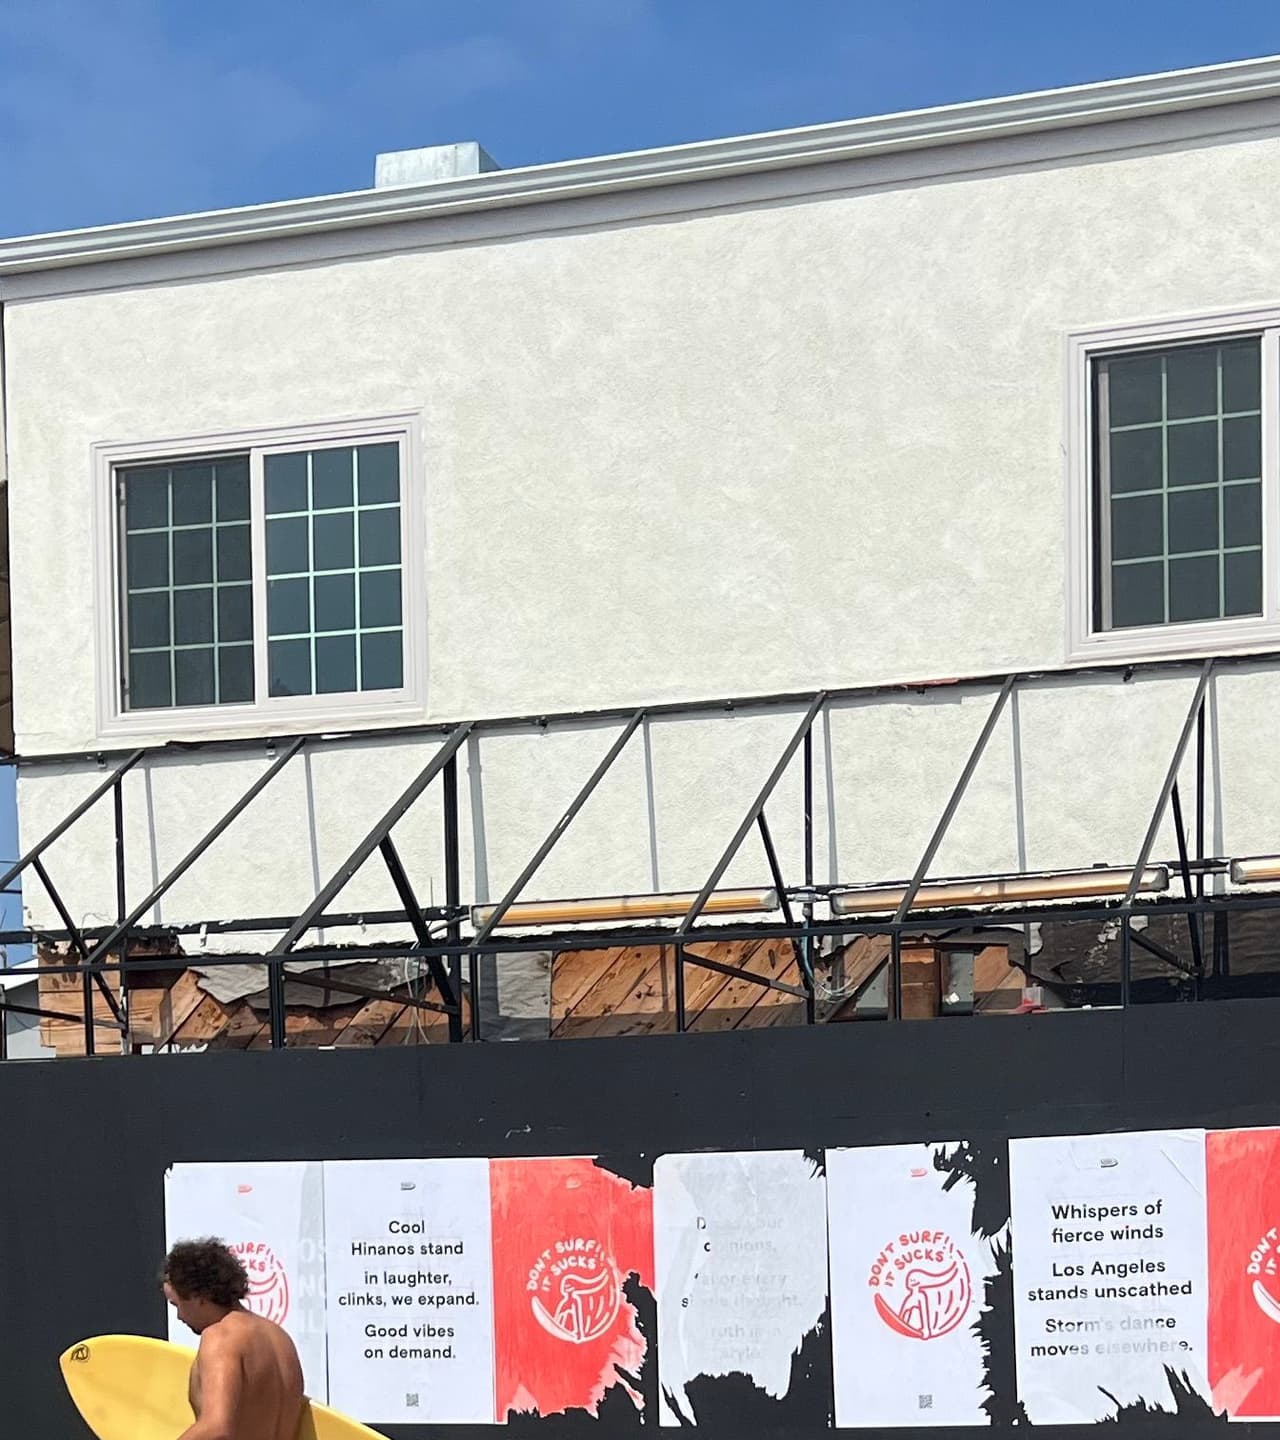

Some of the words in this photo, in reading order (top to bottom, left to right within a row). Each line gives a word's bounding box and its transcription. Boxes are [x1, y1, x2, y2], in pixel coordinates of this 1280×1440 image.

[1052, 1203, 1138, 1221] Whispers
[1144, 1199, 1163, 1215] of
[388, 1220, 425, 1234] Cool
[1052, 1227, 1104, 1243] fierce
[1110, 1224, 1164, 1240] winds
[351, 1242, 415, 1256] Hinanos
[420, 1241, 464, 1255] stand
[550, 1255, 597, 1276] SUCKS
[894, 1248, 944, 1270] SUCKS
[1052, 1262, 1085, 1277] Los
[1090, 1259, 1166, 1278] Angeles
[364, 1271, 378, 1284] in
[383, 1270, 452, 1288] laughter,
[1028, 1285, 1088, 1301] stands
[1095, 1280, 1193, 1299] unscathed
[338, 1292, 387, 1307] clinks,
[391, 1295, 413, 1305] we
[418, 1291, 479, 1309] expand.
[364, 1324, 408, 1338] Good
[413, 1323, 455, 1338] vibes
[1045, 1317, 1113, 1333] Storm's
[1119, 1315, 1177, 1332] dance
[364, 1349, 384, 1359] on
[389, 1345, 456, 1359] demand.
[1031, 1344, 1089, 1357] moves
